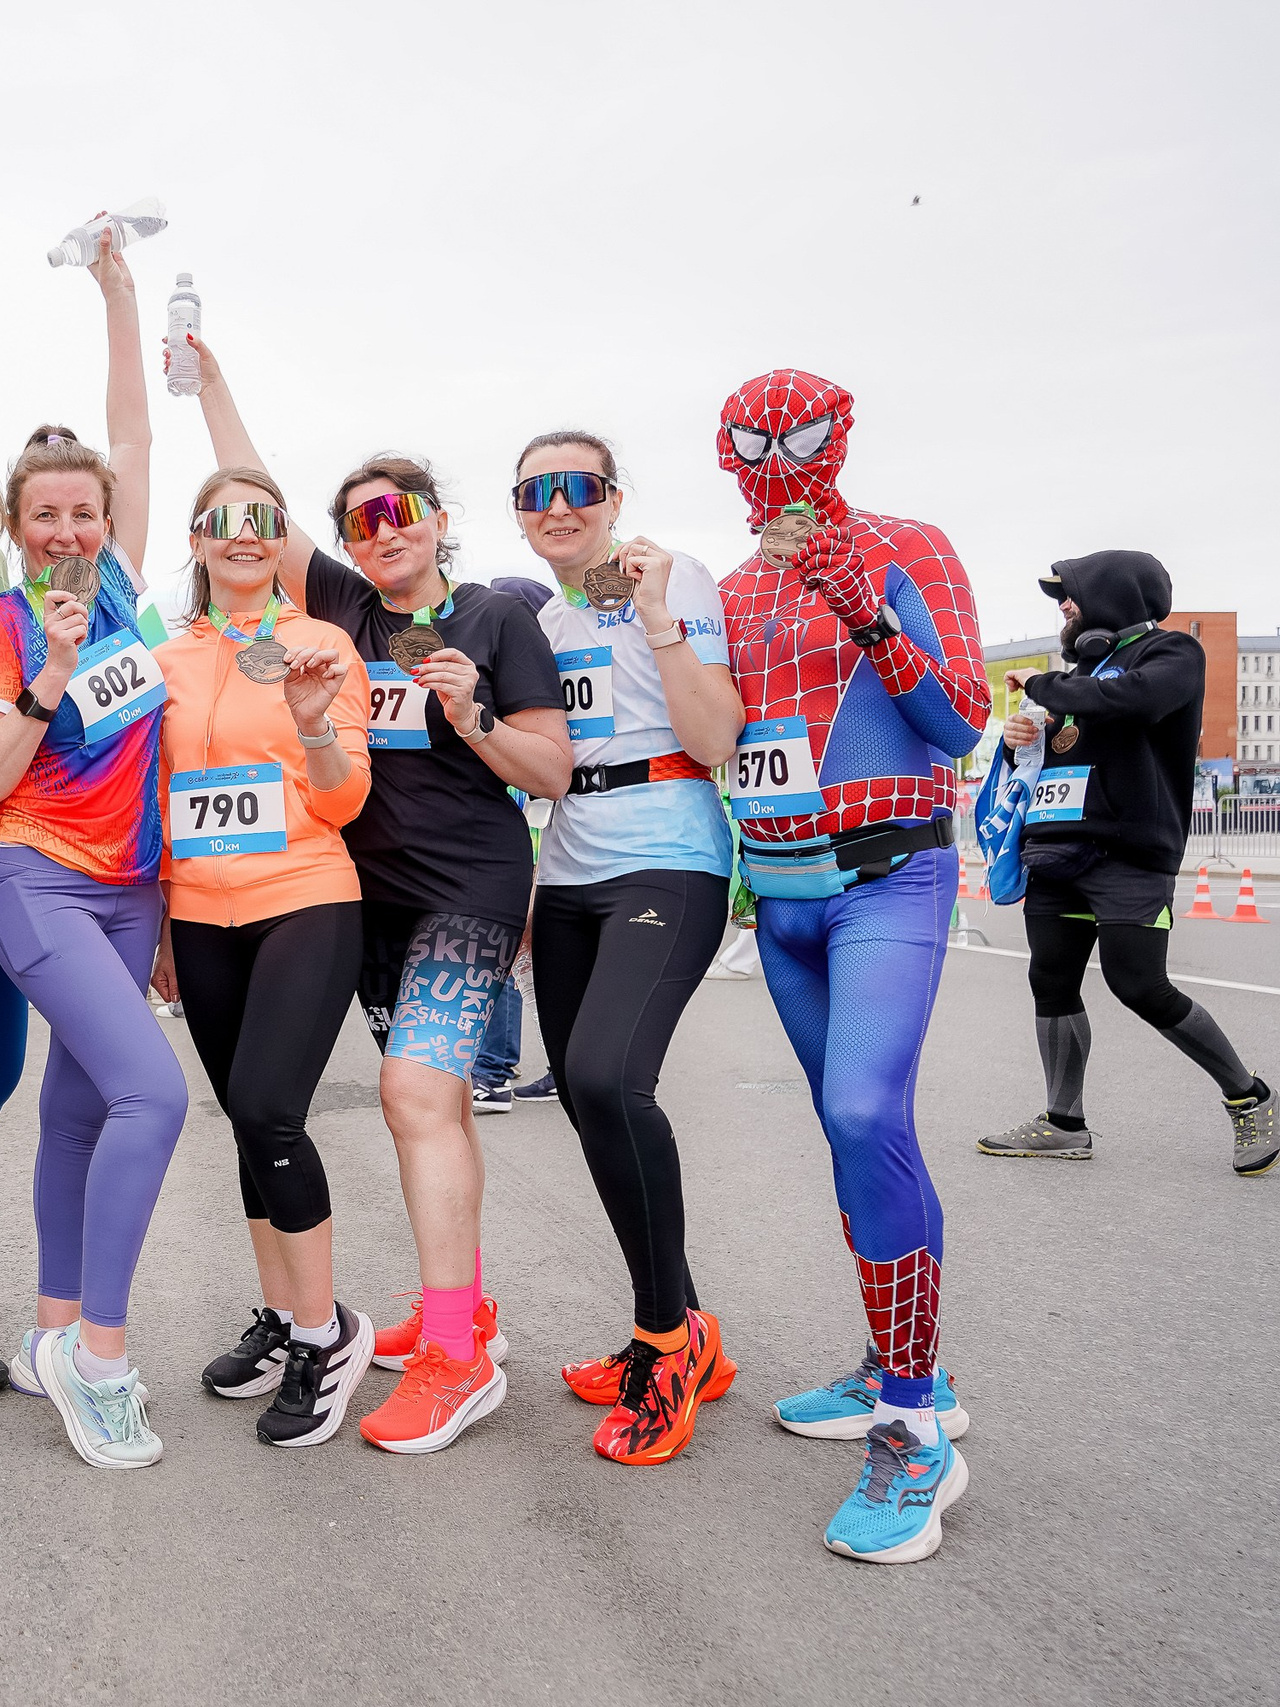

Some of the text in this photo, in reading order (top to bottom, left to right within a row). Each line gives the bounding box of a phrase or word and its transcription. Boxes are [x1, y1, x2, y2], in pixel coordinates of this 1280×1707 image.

[88, 656, 146, 708] 802
[562, 676, 593, 713] 00
[118, 709, 131, 724] 10
[370, 688, 407, 721] 97
[738, 749, 788, 789] 570
[748, 801, 760, 814] 10
[1036, 783, 1070, 806] 959
[189, 791, 259, 830] 790
[209, 840, 224, 853] 10
[628, 917, 666, 927] DEMIX
